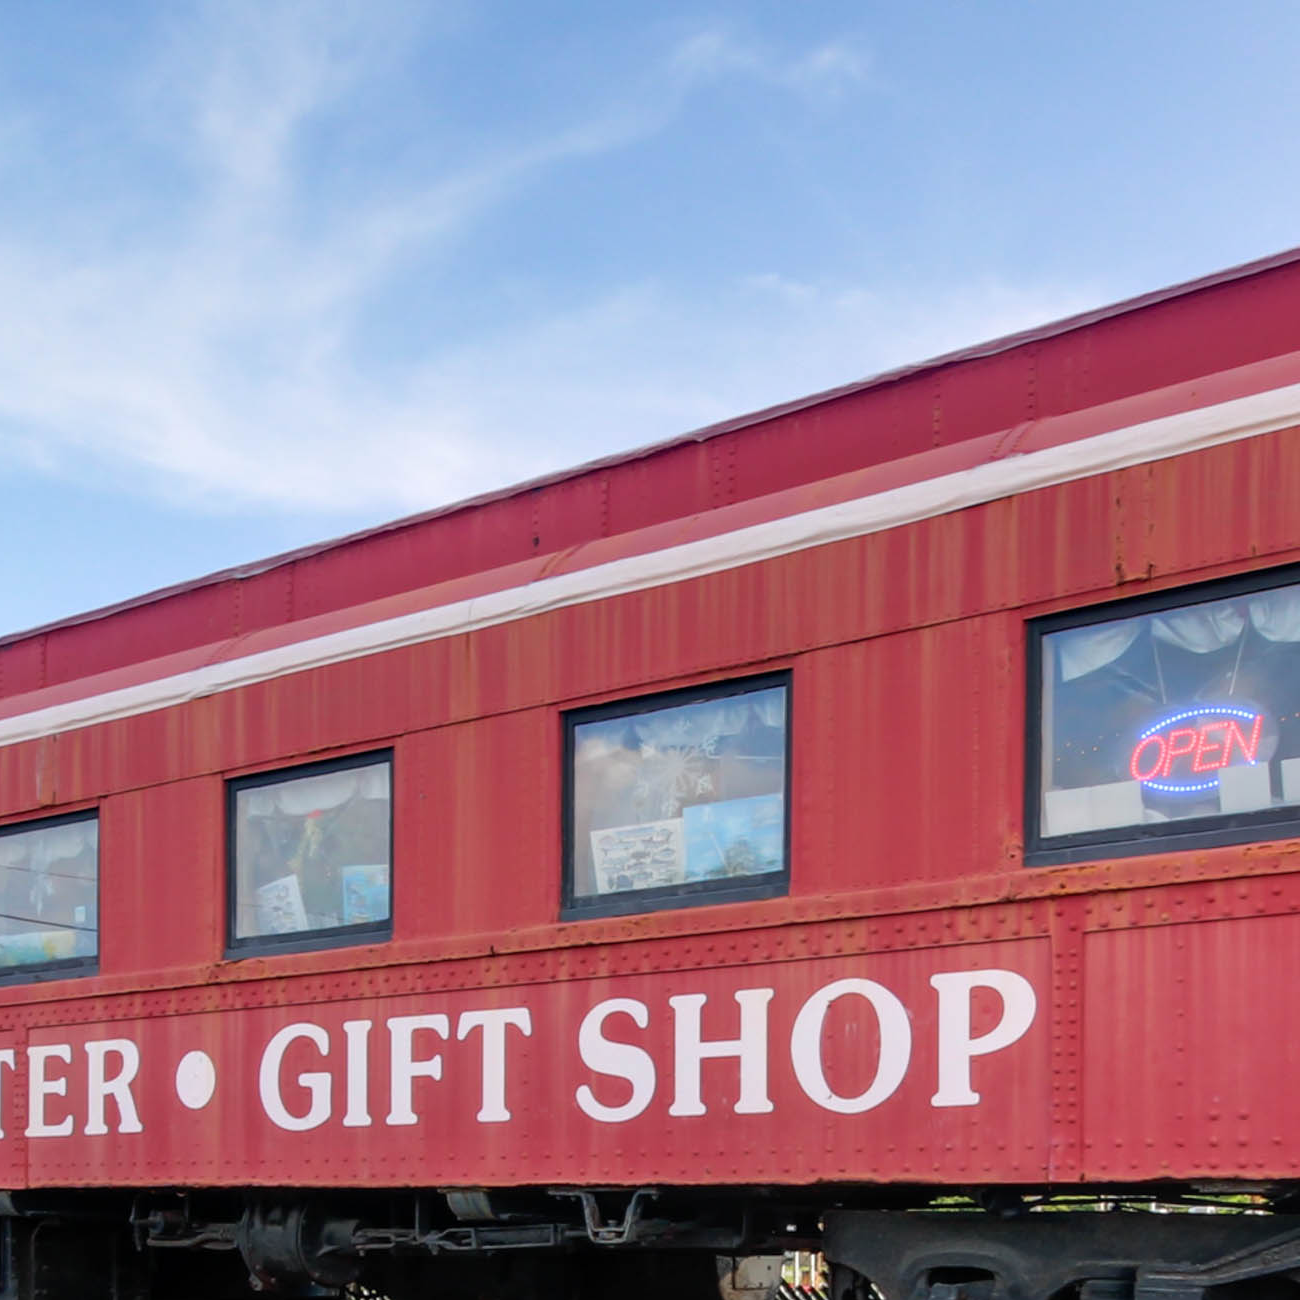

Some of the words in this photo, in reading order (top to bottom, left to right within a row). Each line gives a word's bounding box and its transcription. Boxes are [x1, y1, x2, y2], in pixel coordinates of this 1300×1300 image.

[1129, 714, 1263, 783] OPEN
[259, 1007, 532, 1131] GIFT
[575, 968, 1037, 1123] SHOP
